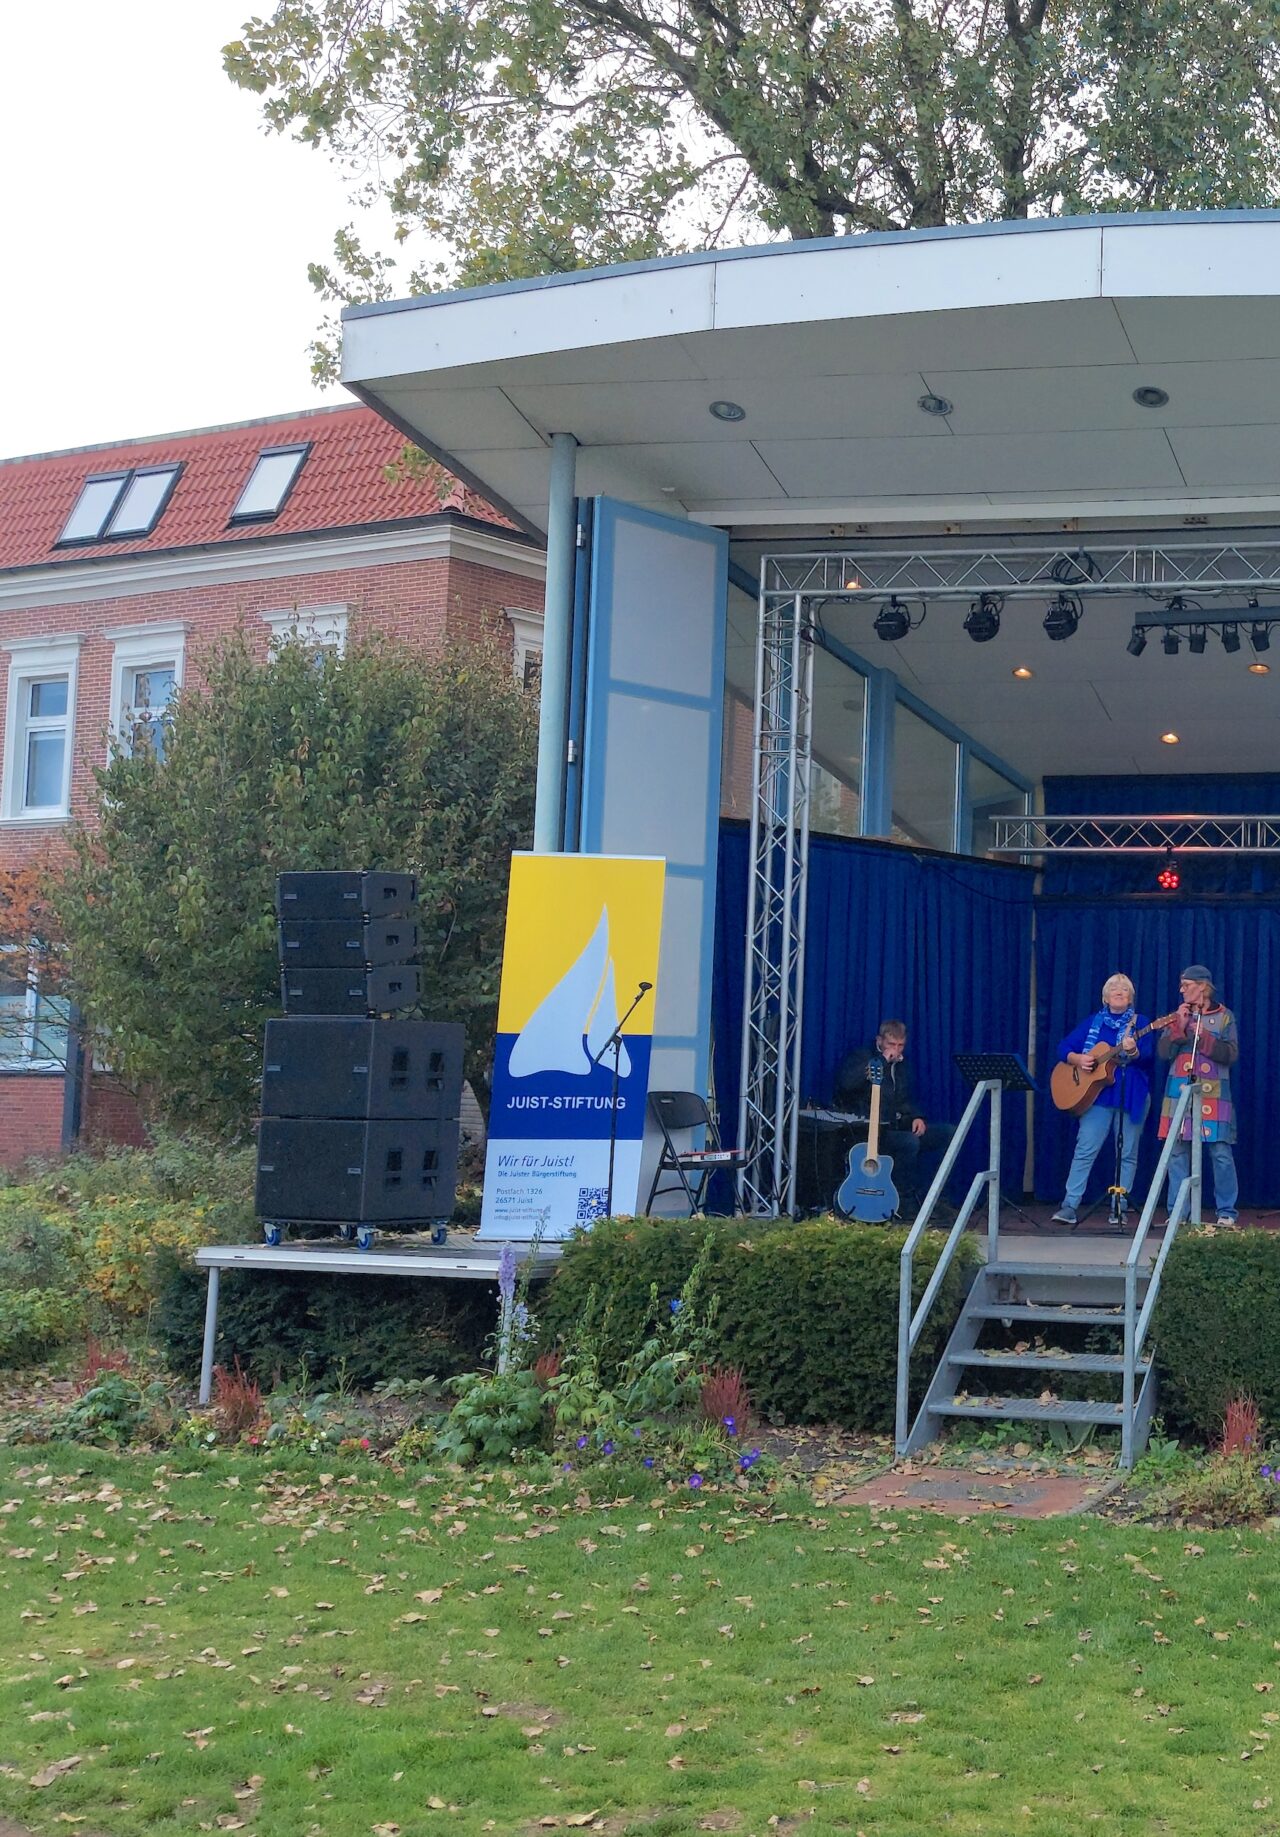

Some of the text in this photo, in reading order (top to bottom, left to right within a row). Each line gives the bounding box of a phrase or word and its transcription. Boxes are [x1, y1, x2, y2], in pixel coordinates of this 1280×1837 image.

[506, 1096, 626, 1110] JUIST-STIFTUNG
[498, 1154, 575, 1167] Wir für Juist!
[531, 1170, 577, 1179] Bürgerstiftung
